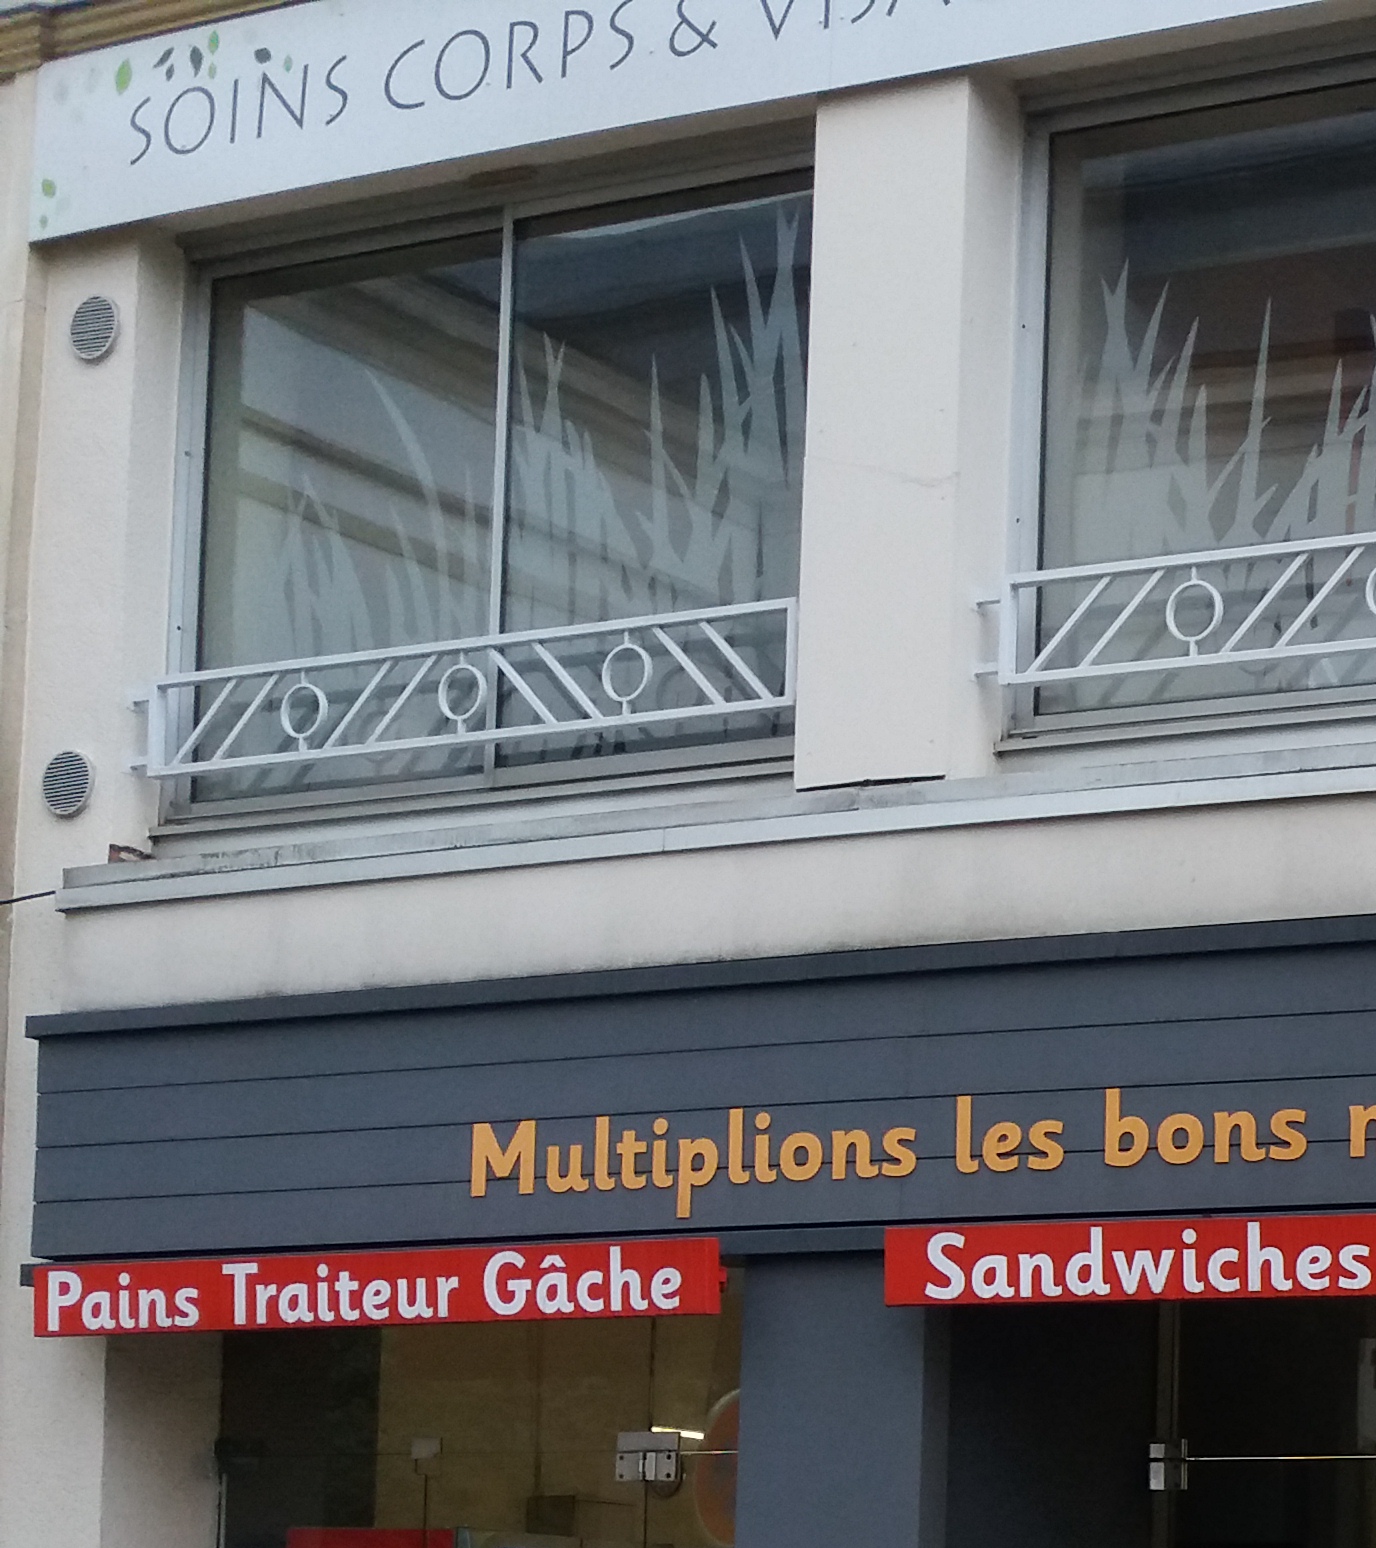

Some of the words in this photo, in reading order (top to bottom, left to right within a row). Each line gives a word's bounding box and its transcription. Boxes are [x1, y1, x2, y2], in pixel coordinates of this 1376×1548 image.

[130, 62, 350, 165] SOINS
[384, 10, 637, 110] CORPS
[667, 0, 719, 57] &
[469, 1107, 917, 1219] Multiplions
[955, 1094, 1064, 1174] les
[1104, 1087, 1308, 1168] bons
[46, 1270, 200, 1333] Pains
[221, 1261, 459, 1326] Traiteur
[482, 1246, 682, 1316] Gâche
[923, 1220, 1373, 1301] Sandwiches
